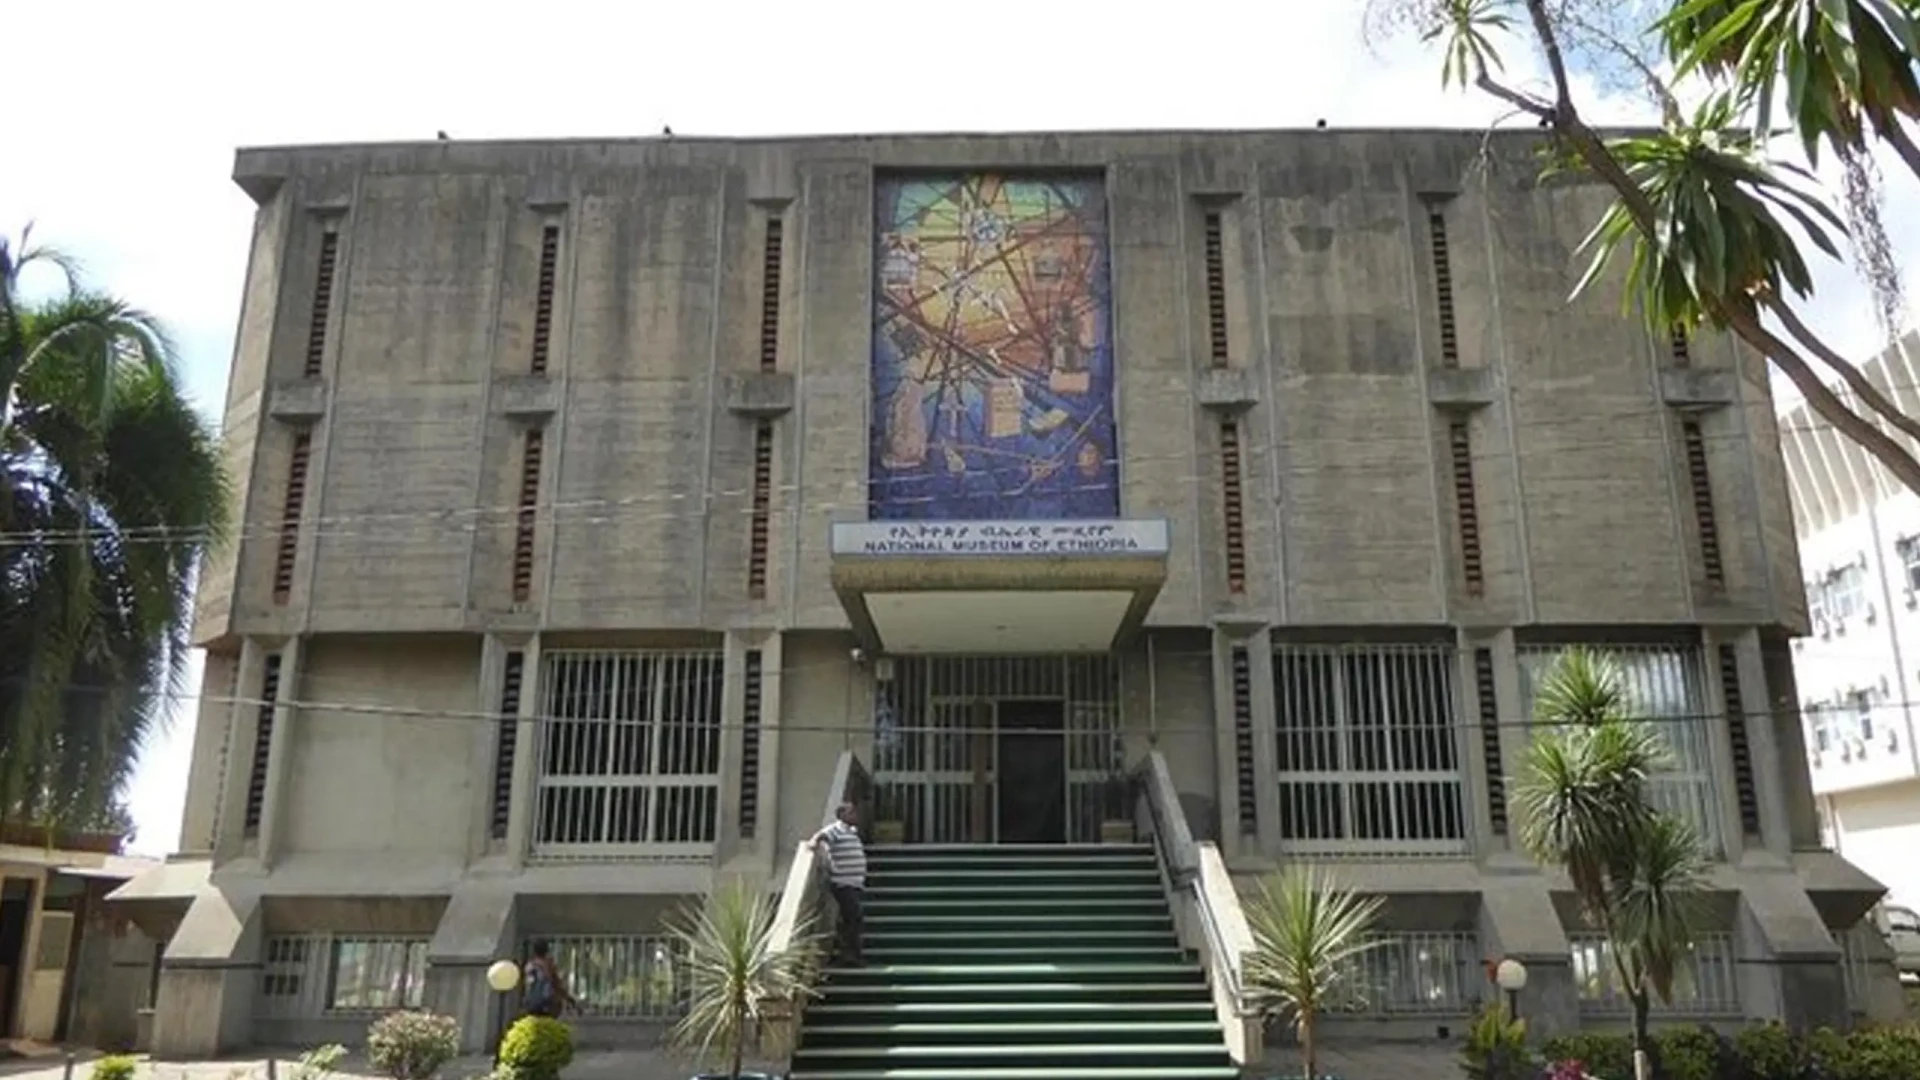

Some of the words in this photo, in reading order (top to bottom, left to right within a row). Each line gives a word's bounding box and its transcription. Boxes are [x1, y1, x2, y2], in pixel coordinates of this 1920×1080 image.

[864, 540, 943, 552] NATIONAL
[952, 539, 1024, 551] MUSEUM
[1028, 539, 1049, 551] OF
[1057, 538, 1138, 550] ETHIOPIA
